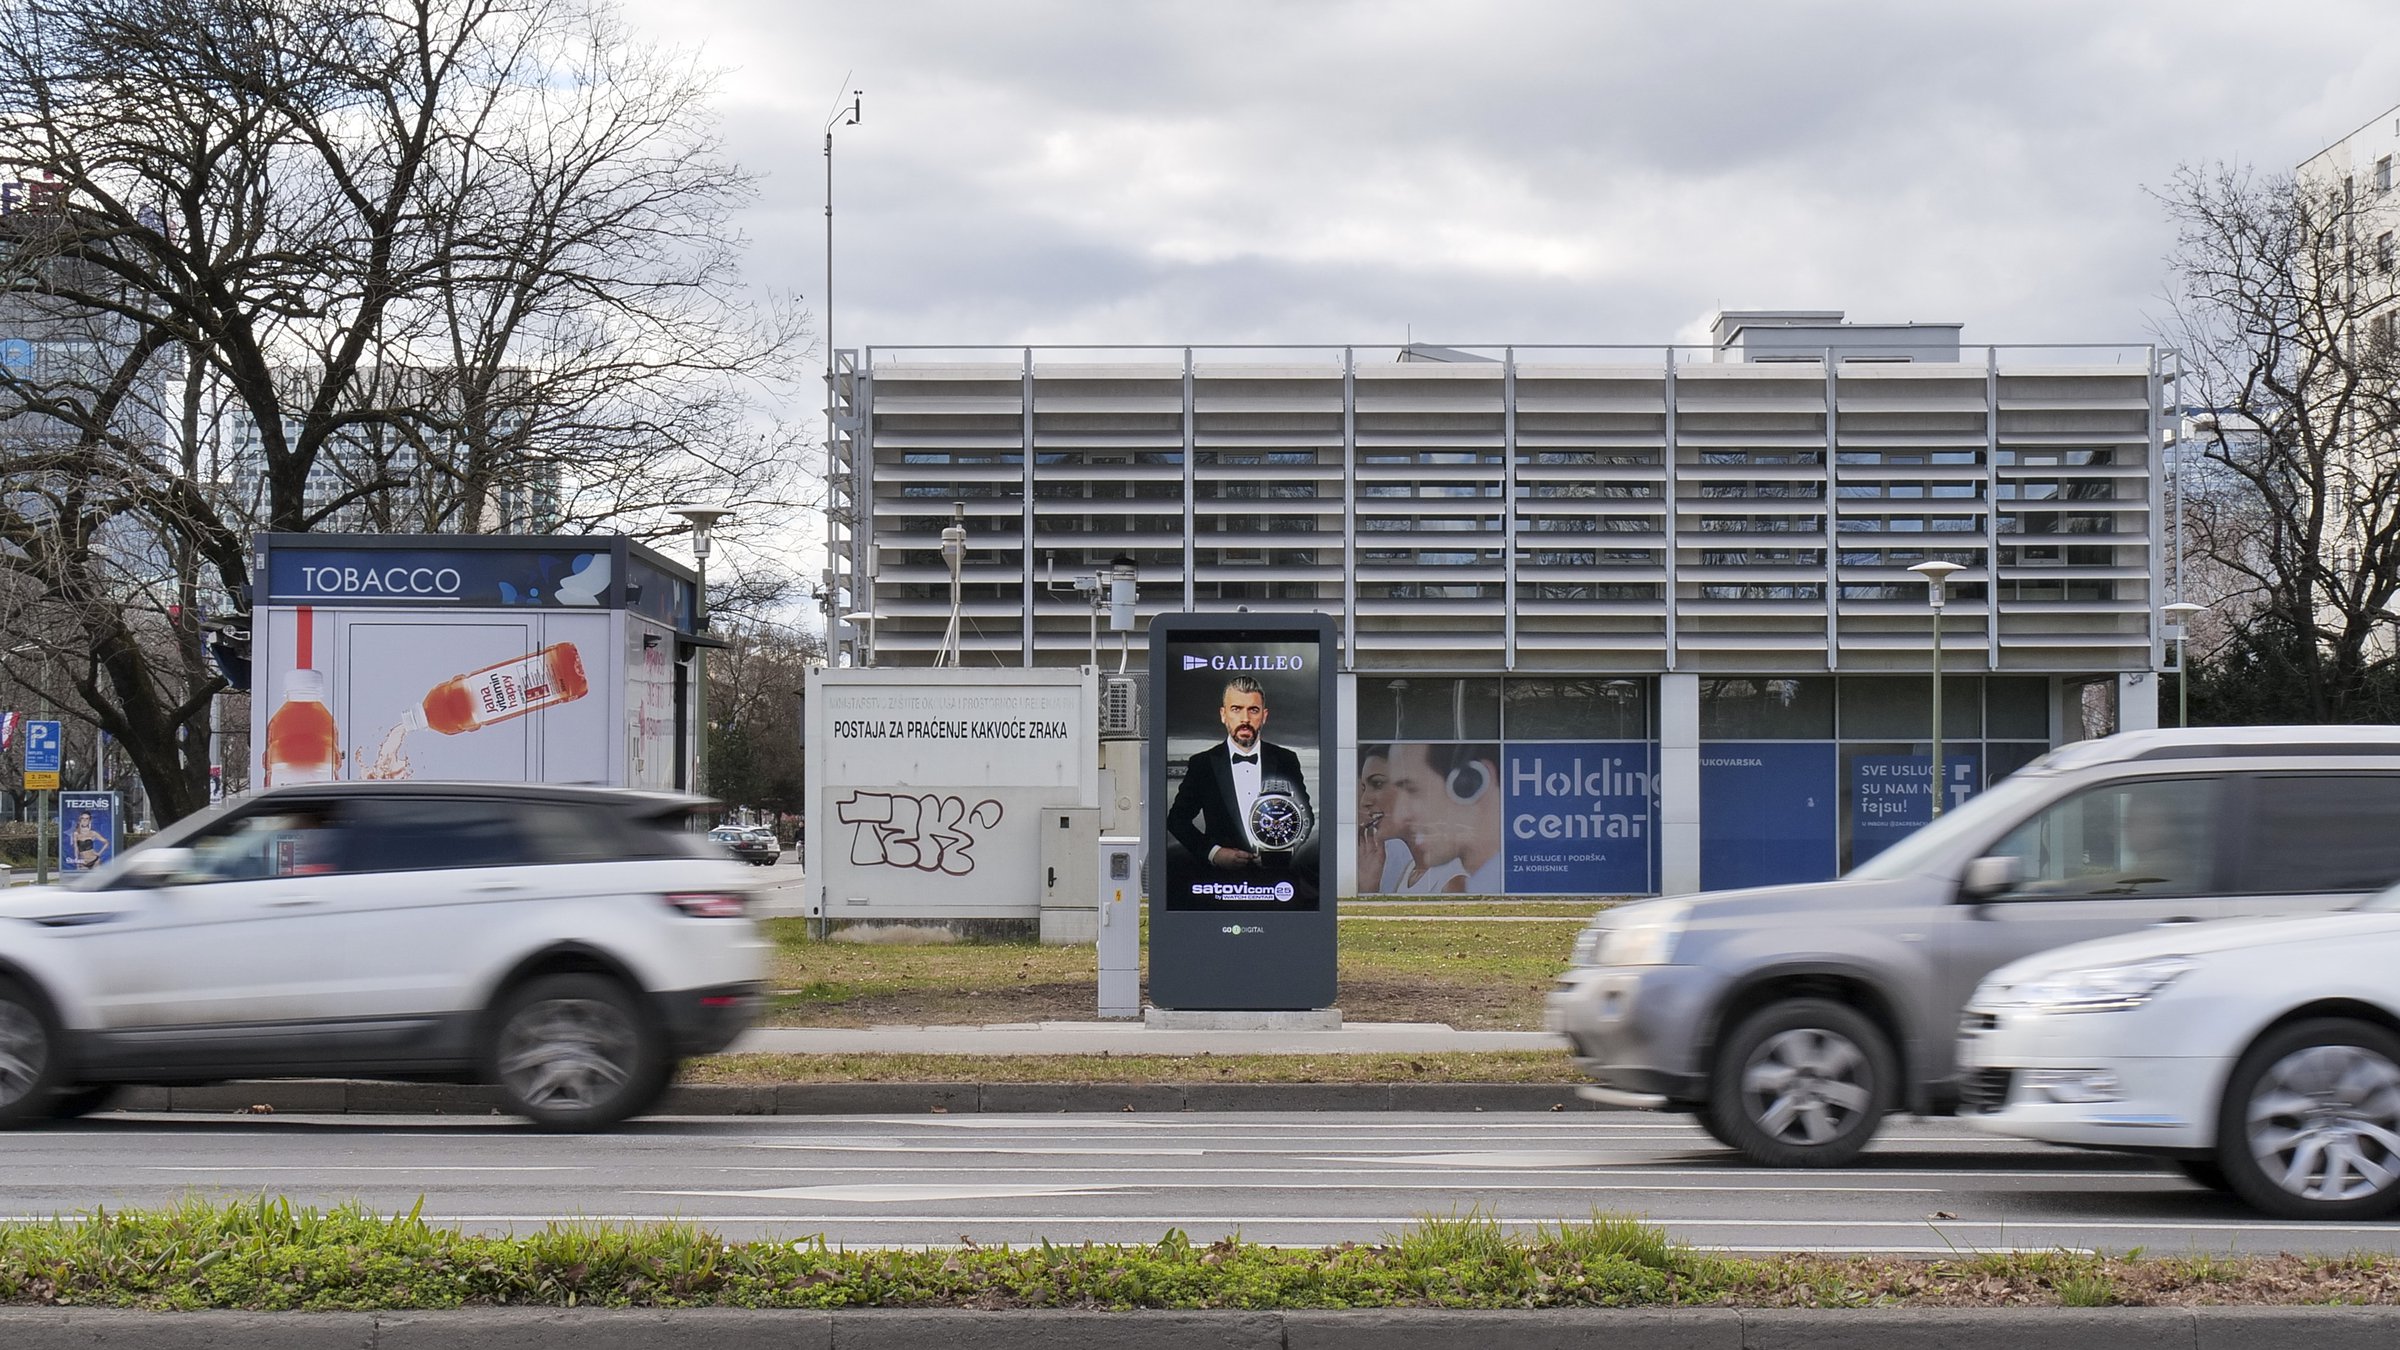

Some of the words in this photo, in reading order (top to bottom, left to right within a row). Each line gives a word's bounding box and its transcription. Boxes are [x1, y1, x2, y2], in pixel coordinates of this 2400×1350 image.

[302, 567, 460, 593] TOBACCO
[1211, 655, 1303, 670] GALILEO
[490, 673, 507, 712] vitamin
[501, 675, 518, 709] happy
[834, 721, 886, 738] POSTAJA
[889, 721, 904, 738] ZA
[907, 716, 967, 738] PRAĆENJE
[971, 716, 1025, 738] KAKVOĆE
[1029, 721, 1067, 738] ZRAKA
[1862, 765, 1887, 776] SVE
[1862, 784, 1880, 794] SU
[1885, 784, 1918, 794] NAM
[65, 798, 110, 808] TEZENIS
[1862, 798, 1907, 817] fejsu!
[1513, 801, 1646, 839] centar
[1568, 853, 1606, 862] PODRŠKA
